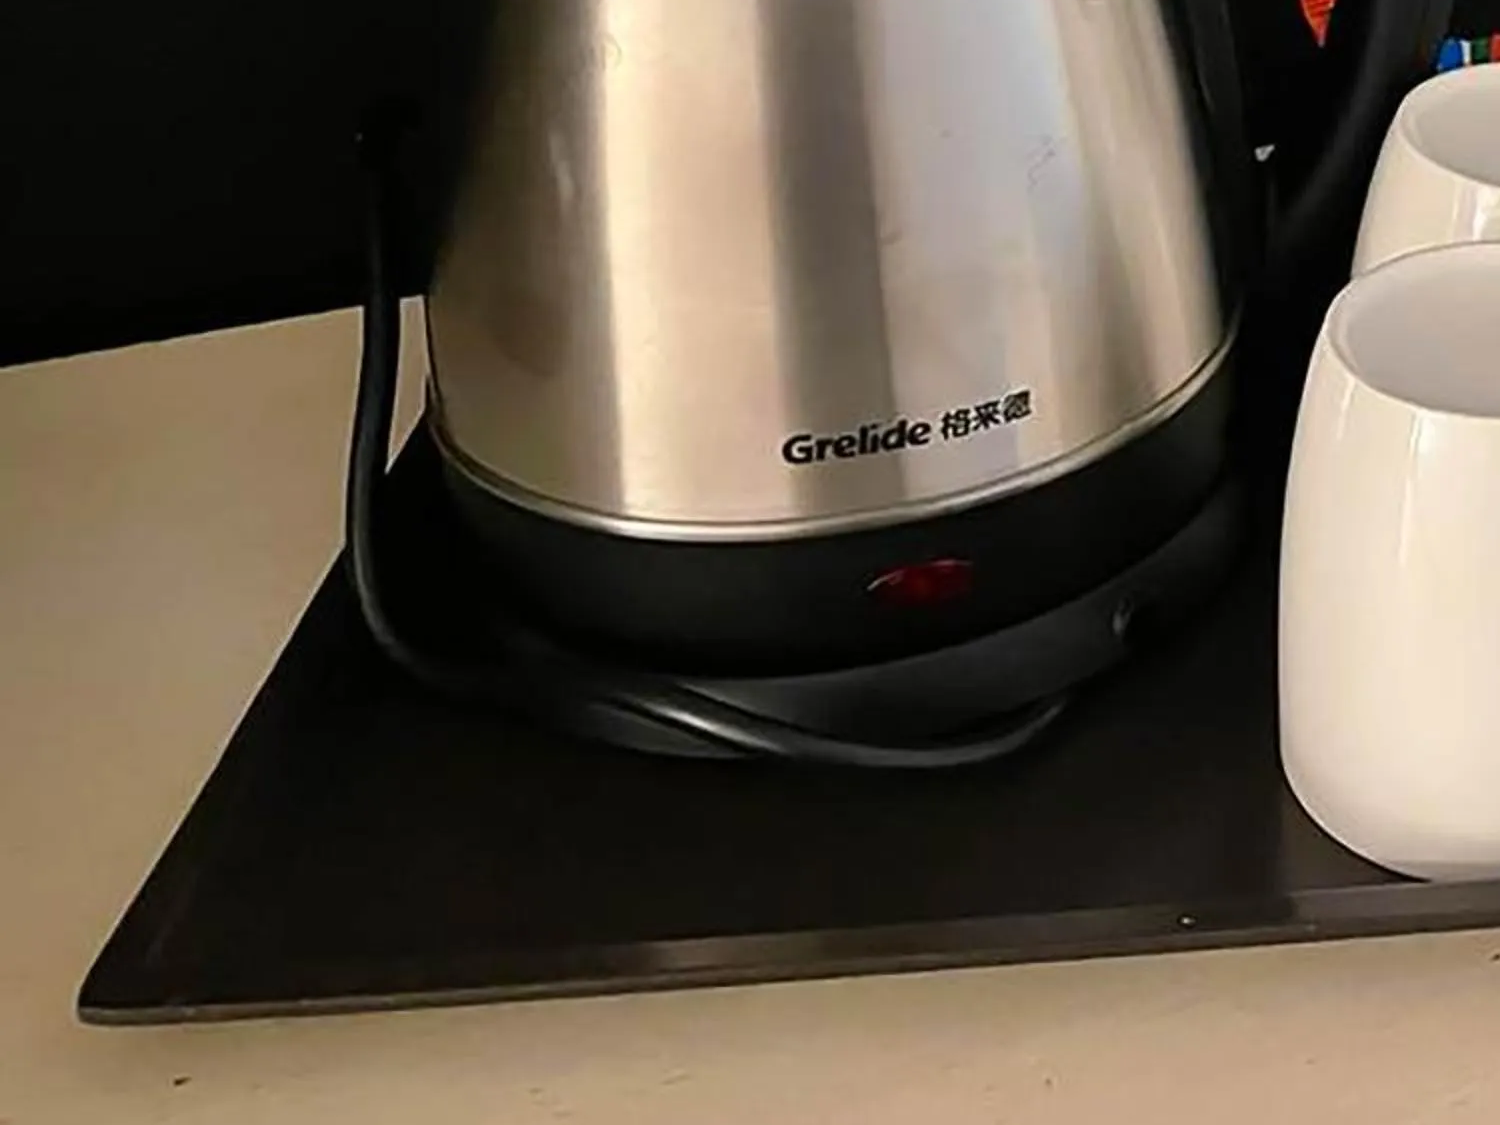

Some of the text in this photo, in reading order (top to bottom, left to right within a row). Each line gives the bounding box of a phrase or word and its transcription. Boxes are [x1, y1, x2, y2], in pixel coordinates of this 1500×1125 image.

[782, 389, 1032, 464] Grelide 格来德
